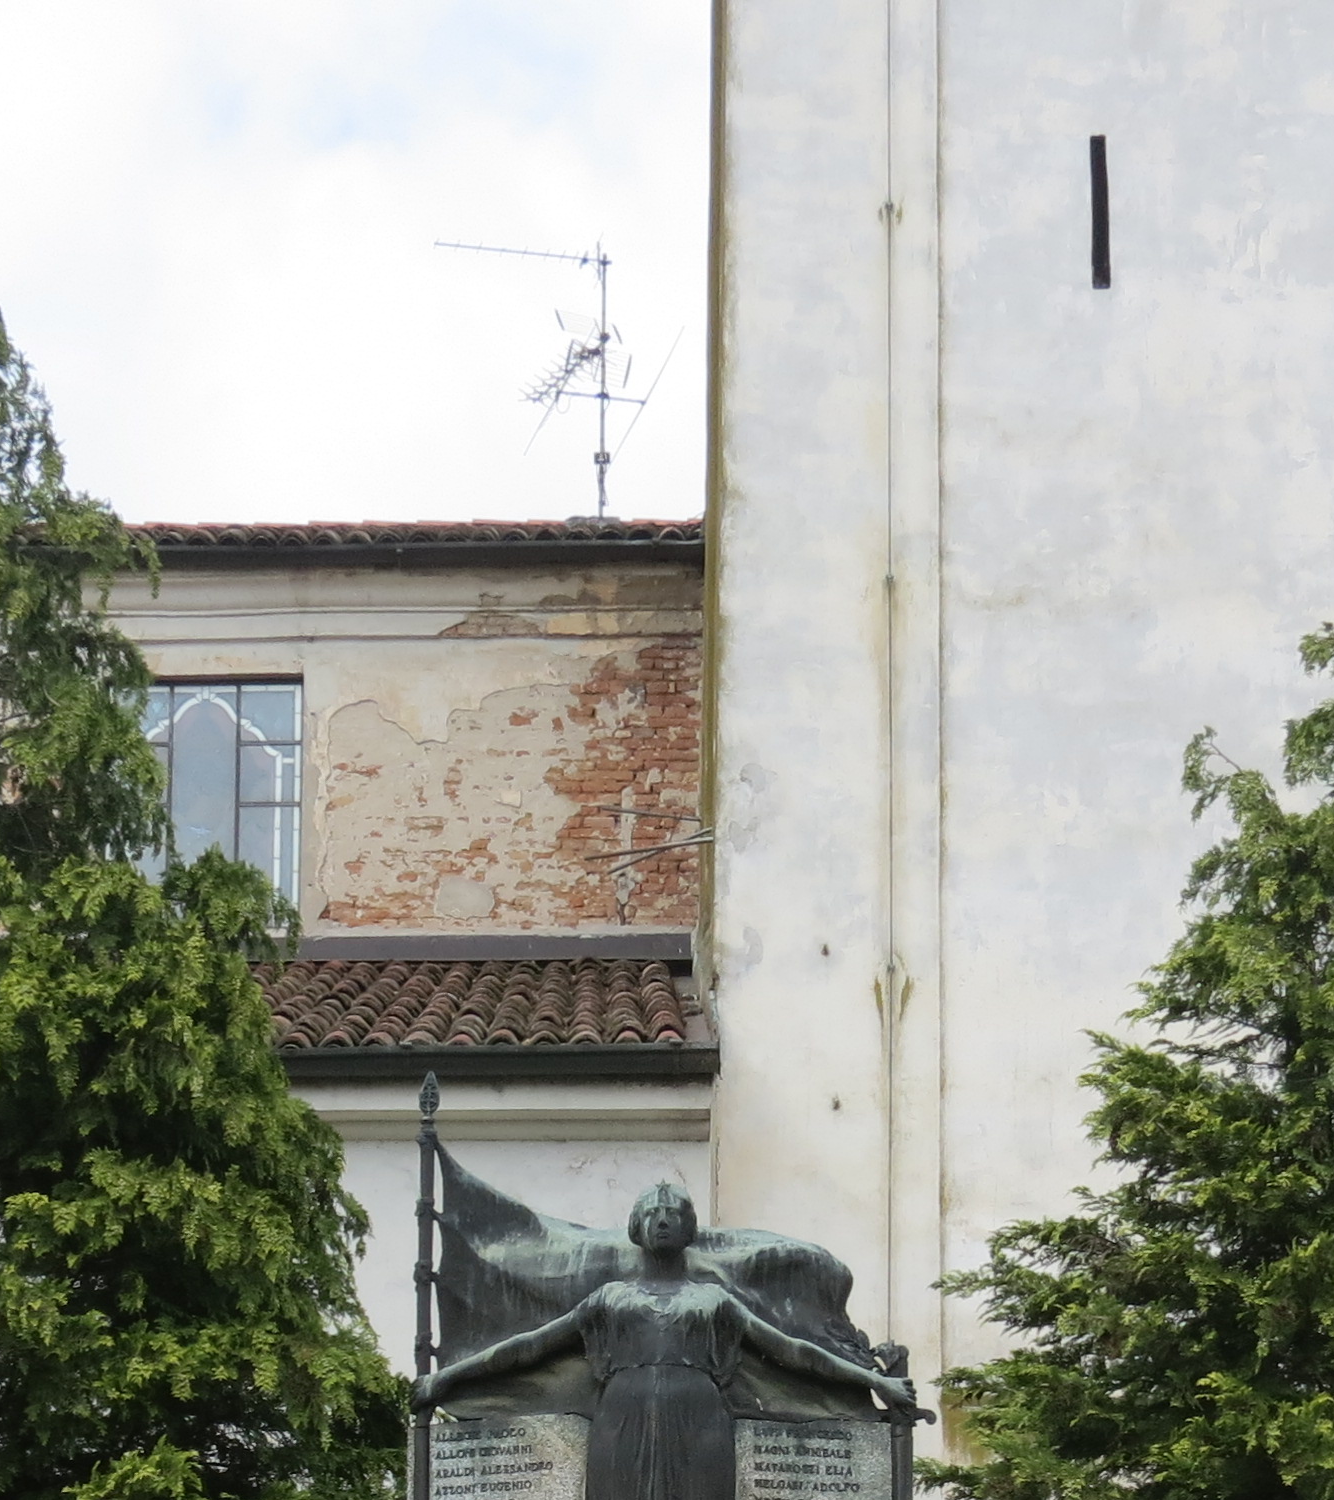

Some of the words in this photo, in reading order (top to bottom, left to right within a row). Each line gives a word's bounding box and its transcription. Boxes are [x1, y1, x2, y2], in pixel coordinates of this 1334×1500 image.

[479, 1445, 532, 1457] GIOVANNI
[481, 1461, 553, 1475] ALESSANDRO
[825, 1465, 853, 1477] ELIA
[434, 1484, 475, 1496] AZZONI
[481, 1480, 532, 1492] EUGENIO
[812, 1482, 860, 1493] ADOLFO
